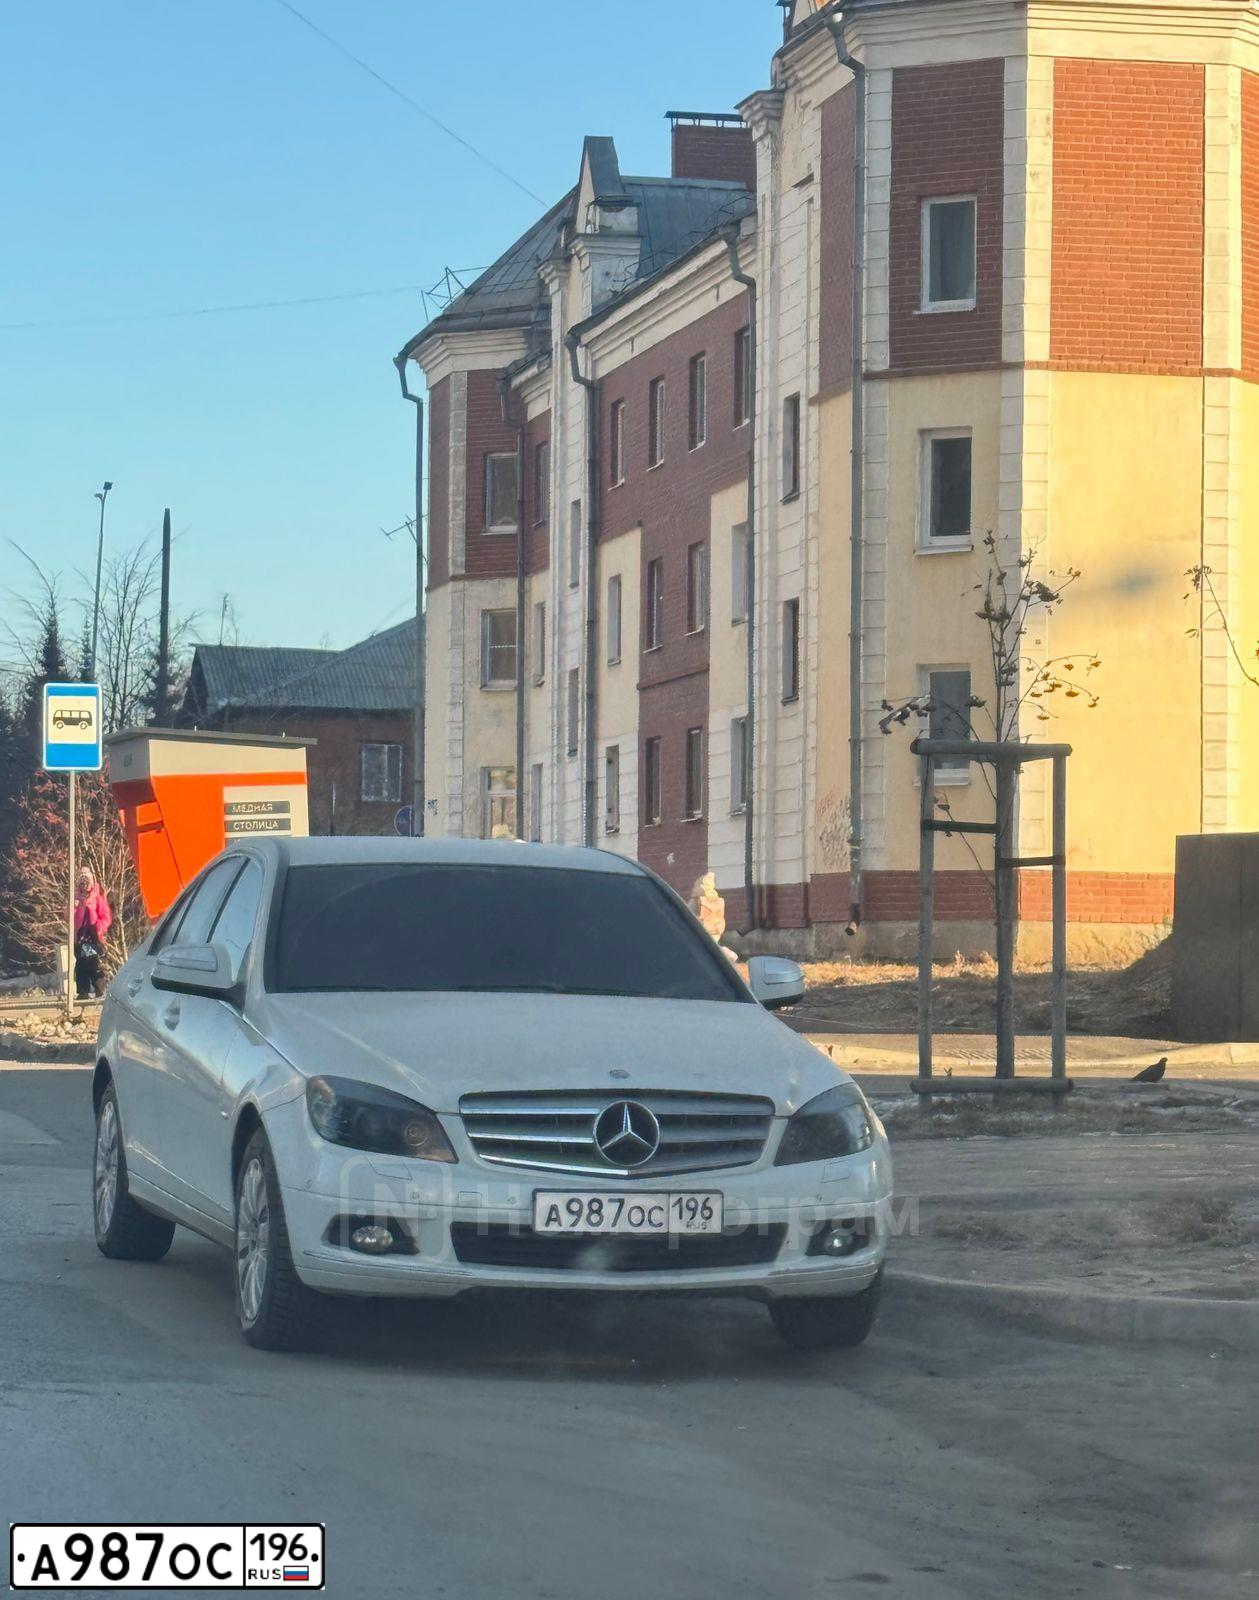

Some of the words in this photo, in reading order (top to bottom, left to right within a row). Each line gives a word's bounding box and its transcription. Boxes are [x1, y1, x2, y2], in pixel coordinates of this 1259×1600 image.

[231, 803, 273, 813] МЕДНАЯ
[233, 820, 279, 830] СТОЛИЦА
[544, 1197, 665, 1228] А987ОС
[671, 1196, 714, 1221] 196
[685, 1222, 708, 1230] RUS
